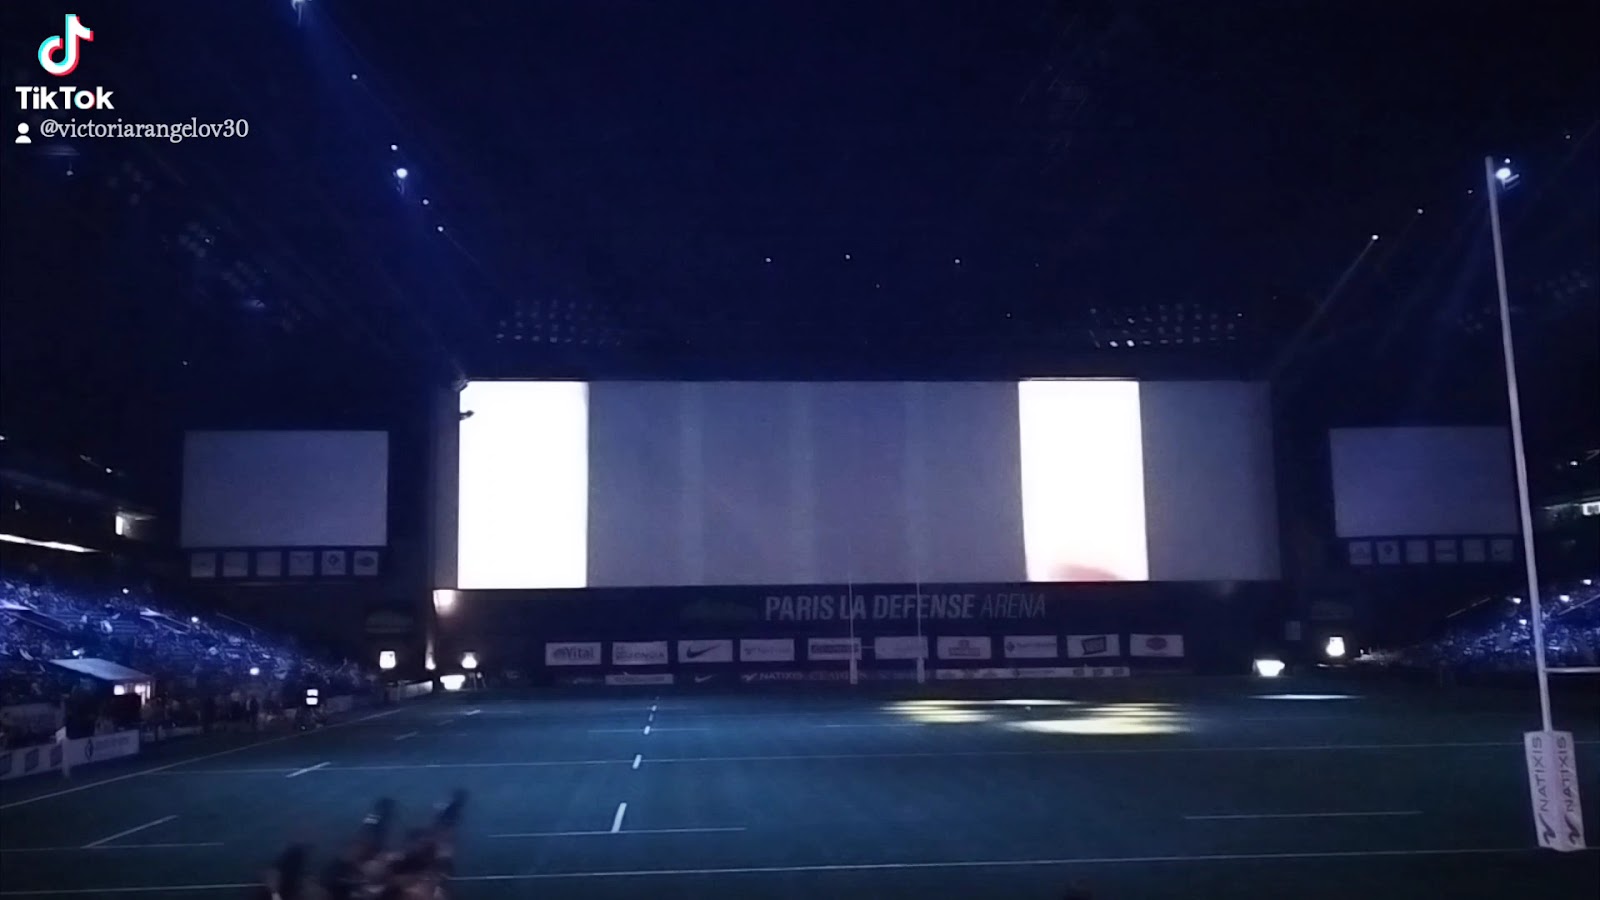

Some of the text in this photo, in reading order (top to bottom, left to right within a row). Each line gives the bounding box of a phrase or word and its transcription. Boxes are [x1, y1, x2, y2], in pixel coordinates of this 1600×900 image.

[765, 593, 1047, 621] PARIS LA DEFENSE ARENA
[1532, 737, 1549, 812] NATIXIS
[1556, 737, 1575, 812] NATIXIS
